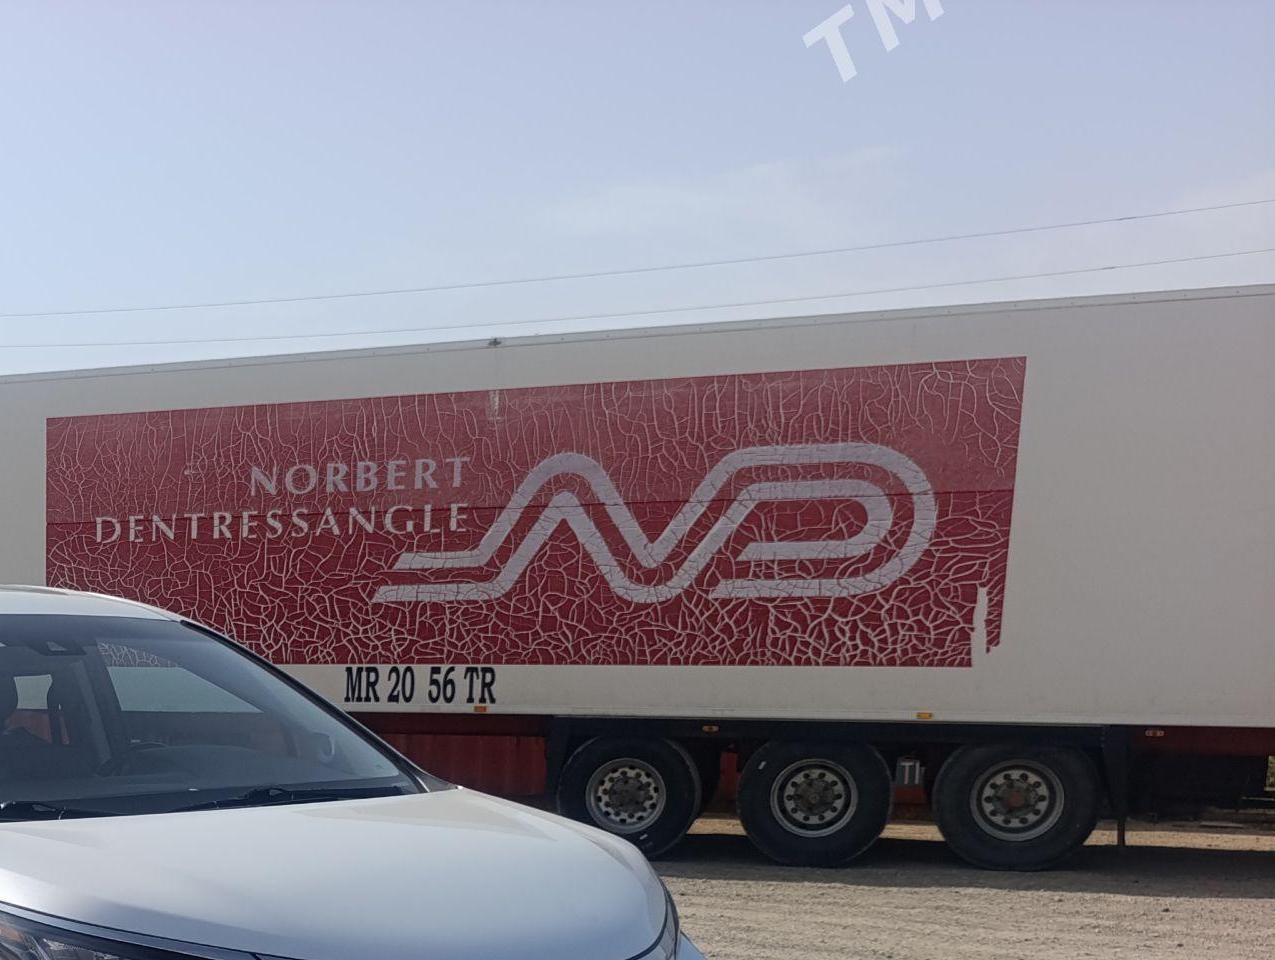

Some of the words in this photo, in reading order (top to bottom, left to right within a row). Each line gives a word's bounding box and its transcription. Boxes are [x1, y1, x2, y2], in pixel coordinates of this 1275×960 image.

[250, 456, 471, 497] NORBERT
[95, 503, 469, 544] DENTRESSANGLE
[344, 666, 380, 703] MR
[387, 666, 415, 703] 20
[428, 666, 456, 703] 56
[463, 667, 496, 704] TR
